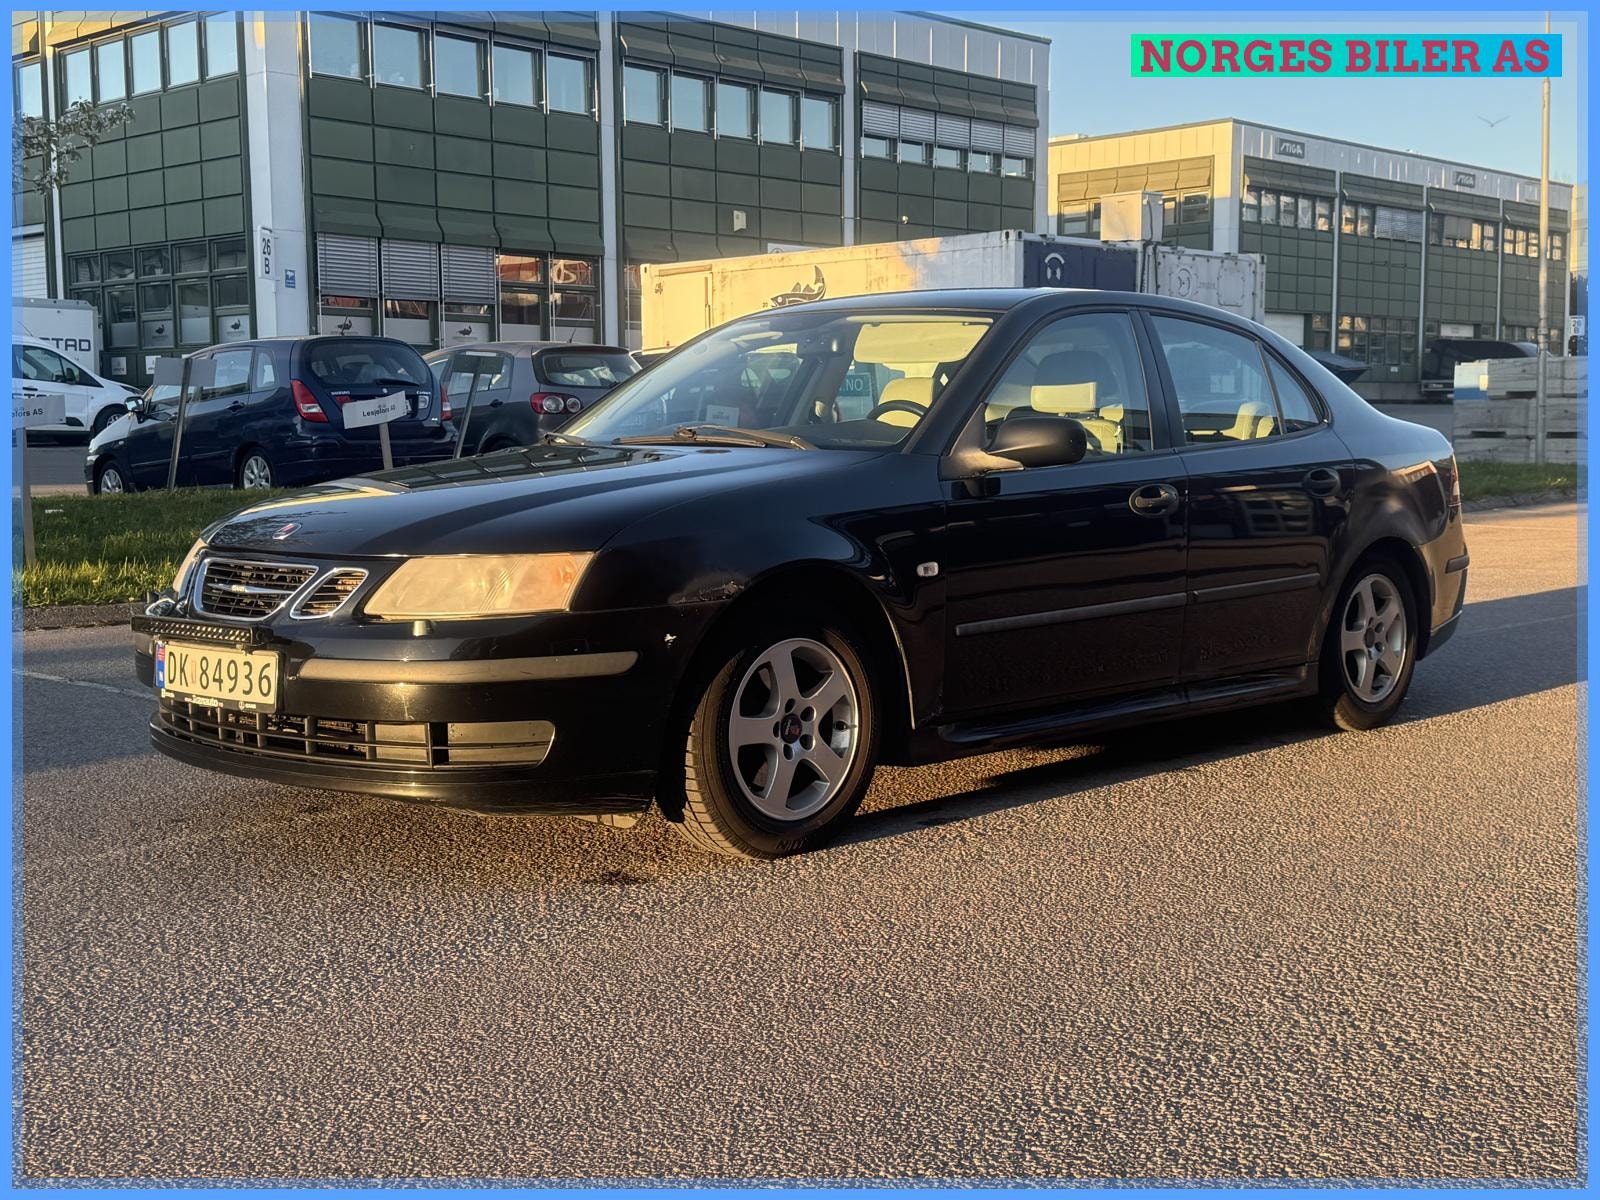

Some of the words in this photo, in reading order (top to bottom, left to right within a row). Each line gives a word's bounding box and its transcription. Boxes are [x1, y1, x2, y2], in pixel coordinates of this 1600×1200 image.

[1280, 142, 1303, 155] STIGA
[262, 237, 271, 256] 26
[264, 257, 271, 274] B
[38, 337, 91, 351] TAD
[33, 408, 44, 416] AS
[168, 651, 189, 687] DK
[199, 656, 272, 697] 84936
